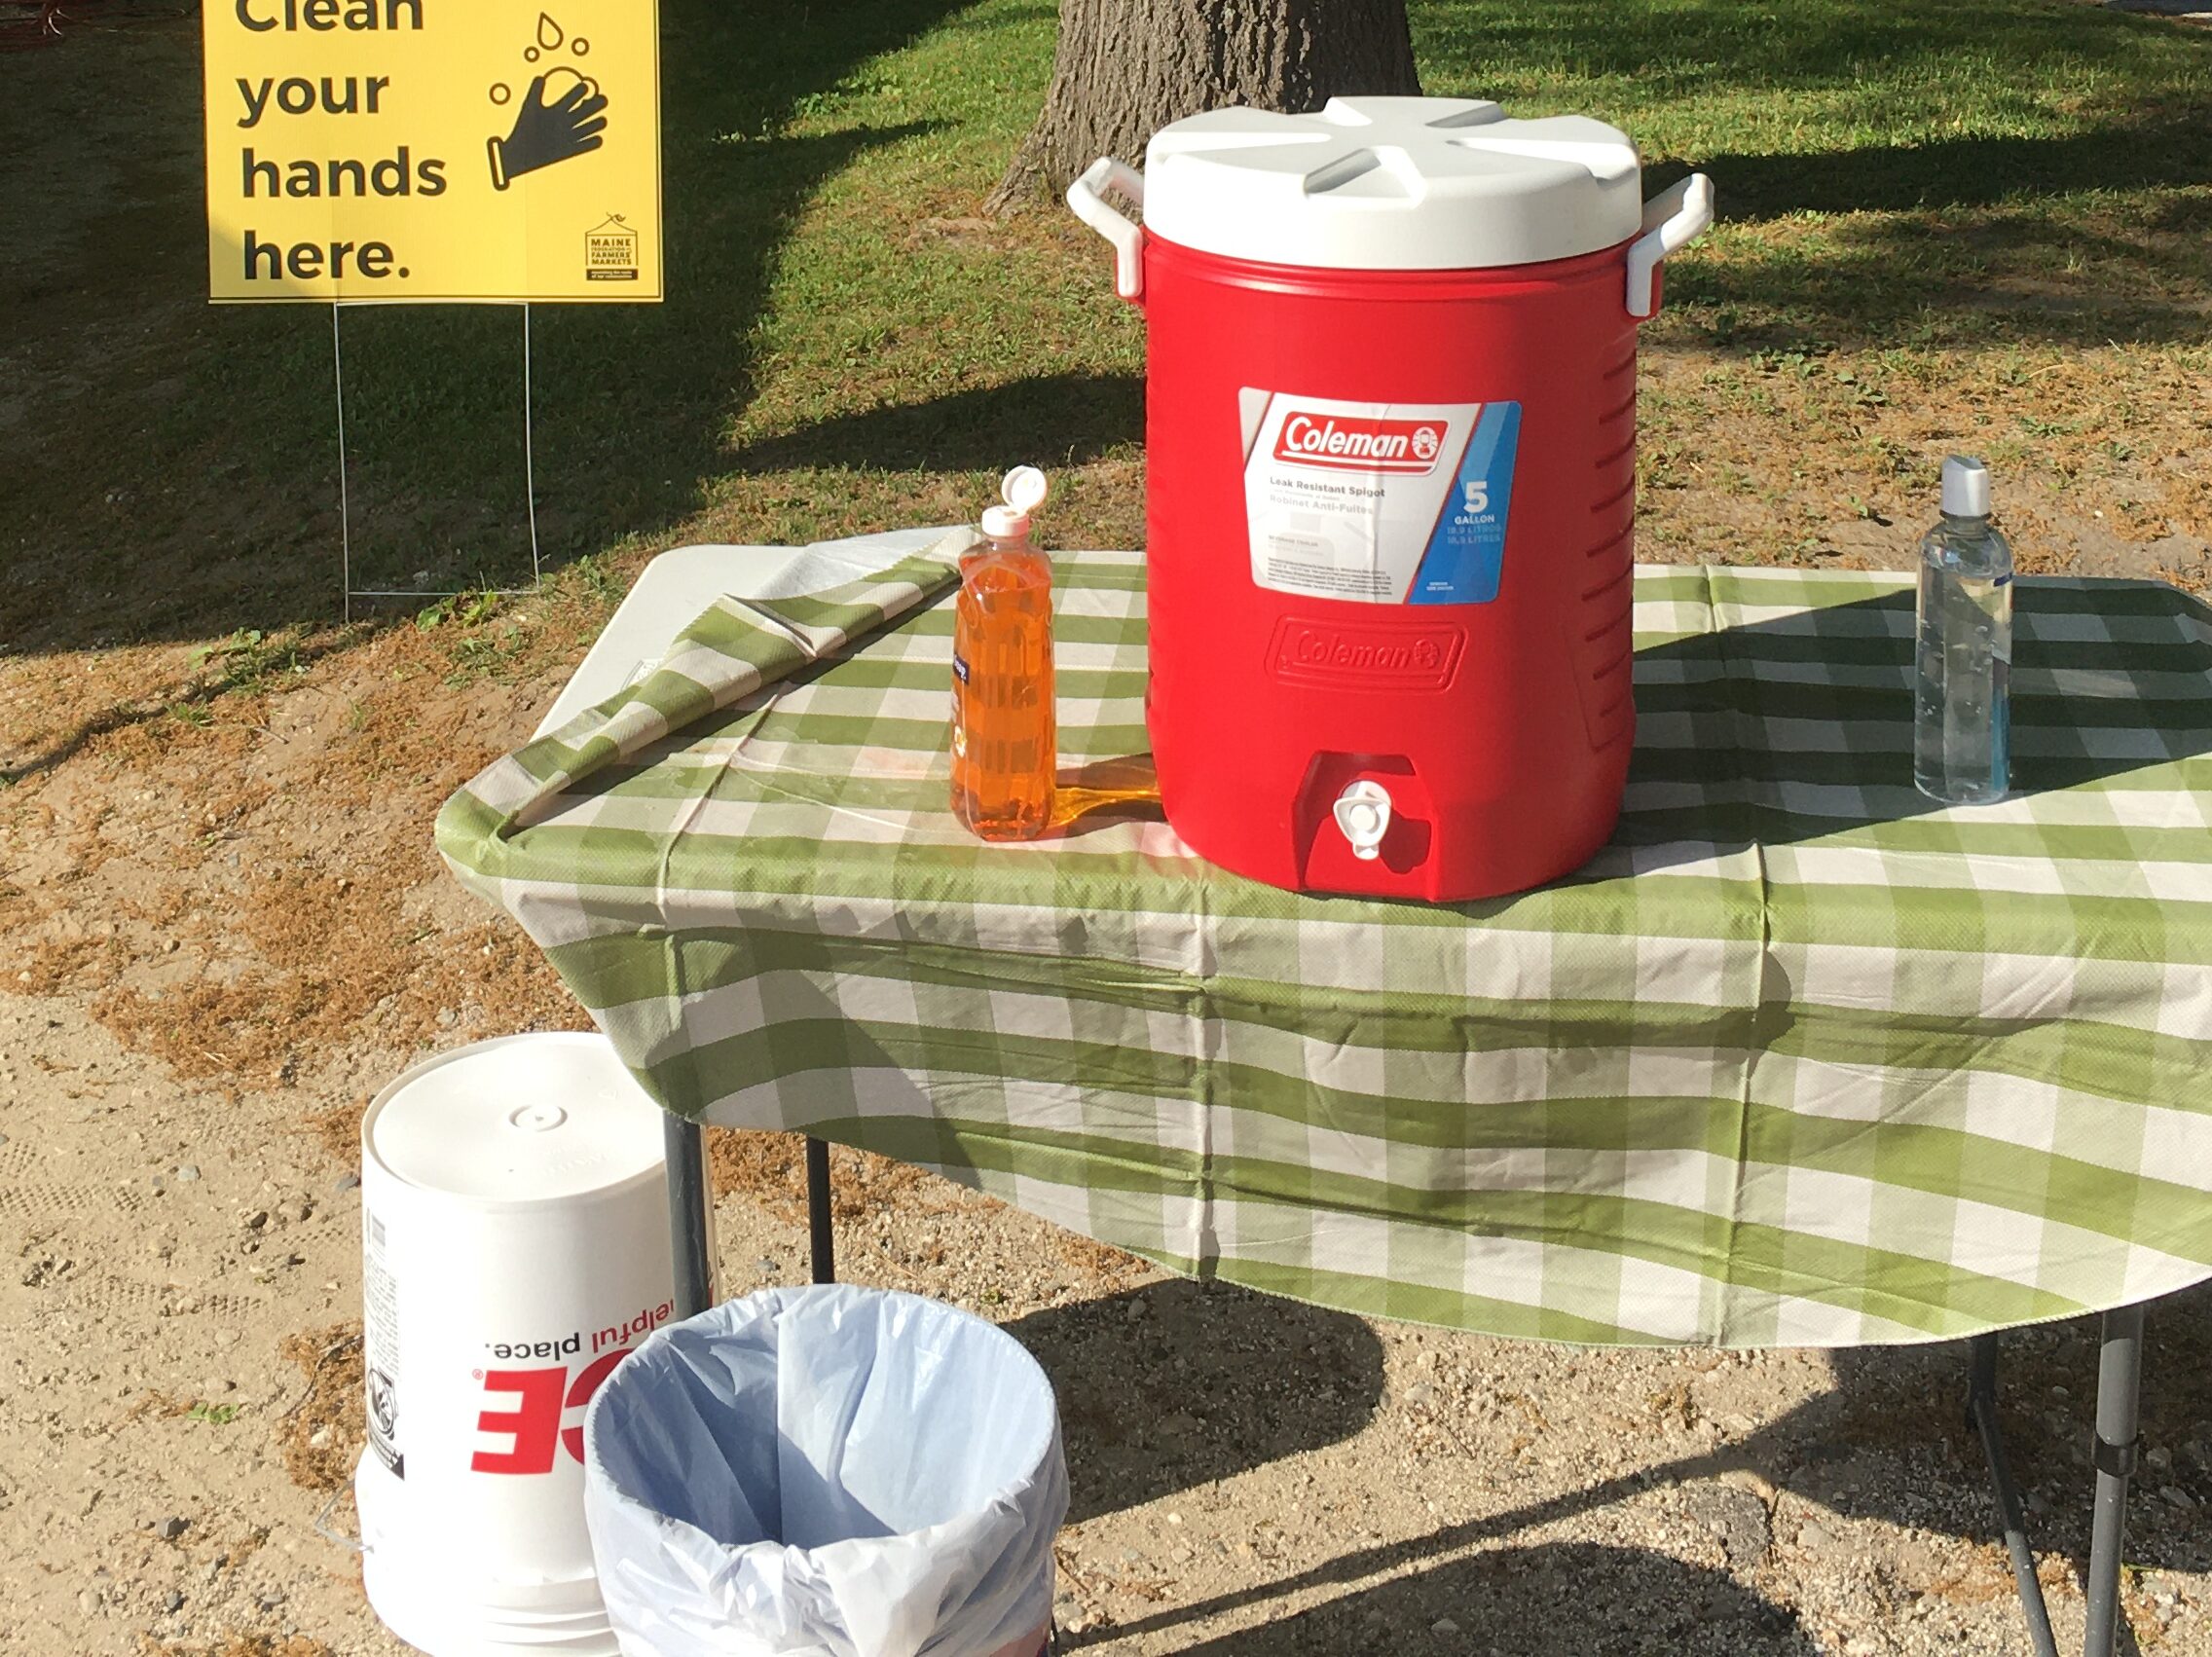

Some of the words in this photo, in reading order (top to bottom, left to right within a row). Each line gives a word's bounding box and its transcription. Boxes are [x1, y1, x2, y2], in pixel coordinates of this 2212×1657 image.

[236, 0, 424, 32] Clean
[236, 74, 390, 128] your
[242, 145, 447, 199] hands
[243, 230, 411, 280] here.
[1285, 416, 1409, 458] Coleman
[1270, 476, 1293, 488] Leak
[1296, 480, 1346, 495] Resistant
[1348, 486, 1385, 497] Spigot
[1463, 481, 1489, 514] 5
[1270, 494, 1309, 509] Robinet
[1312, 500, 1374, 515] Anti-Fuites
[1454, 514, 1495, 525] GALLON
[1298, 630, 1411, 668] Coleman
[485, 1332, 580, 1361] place.
